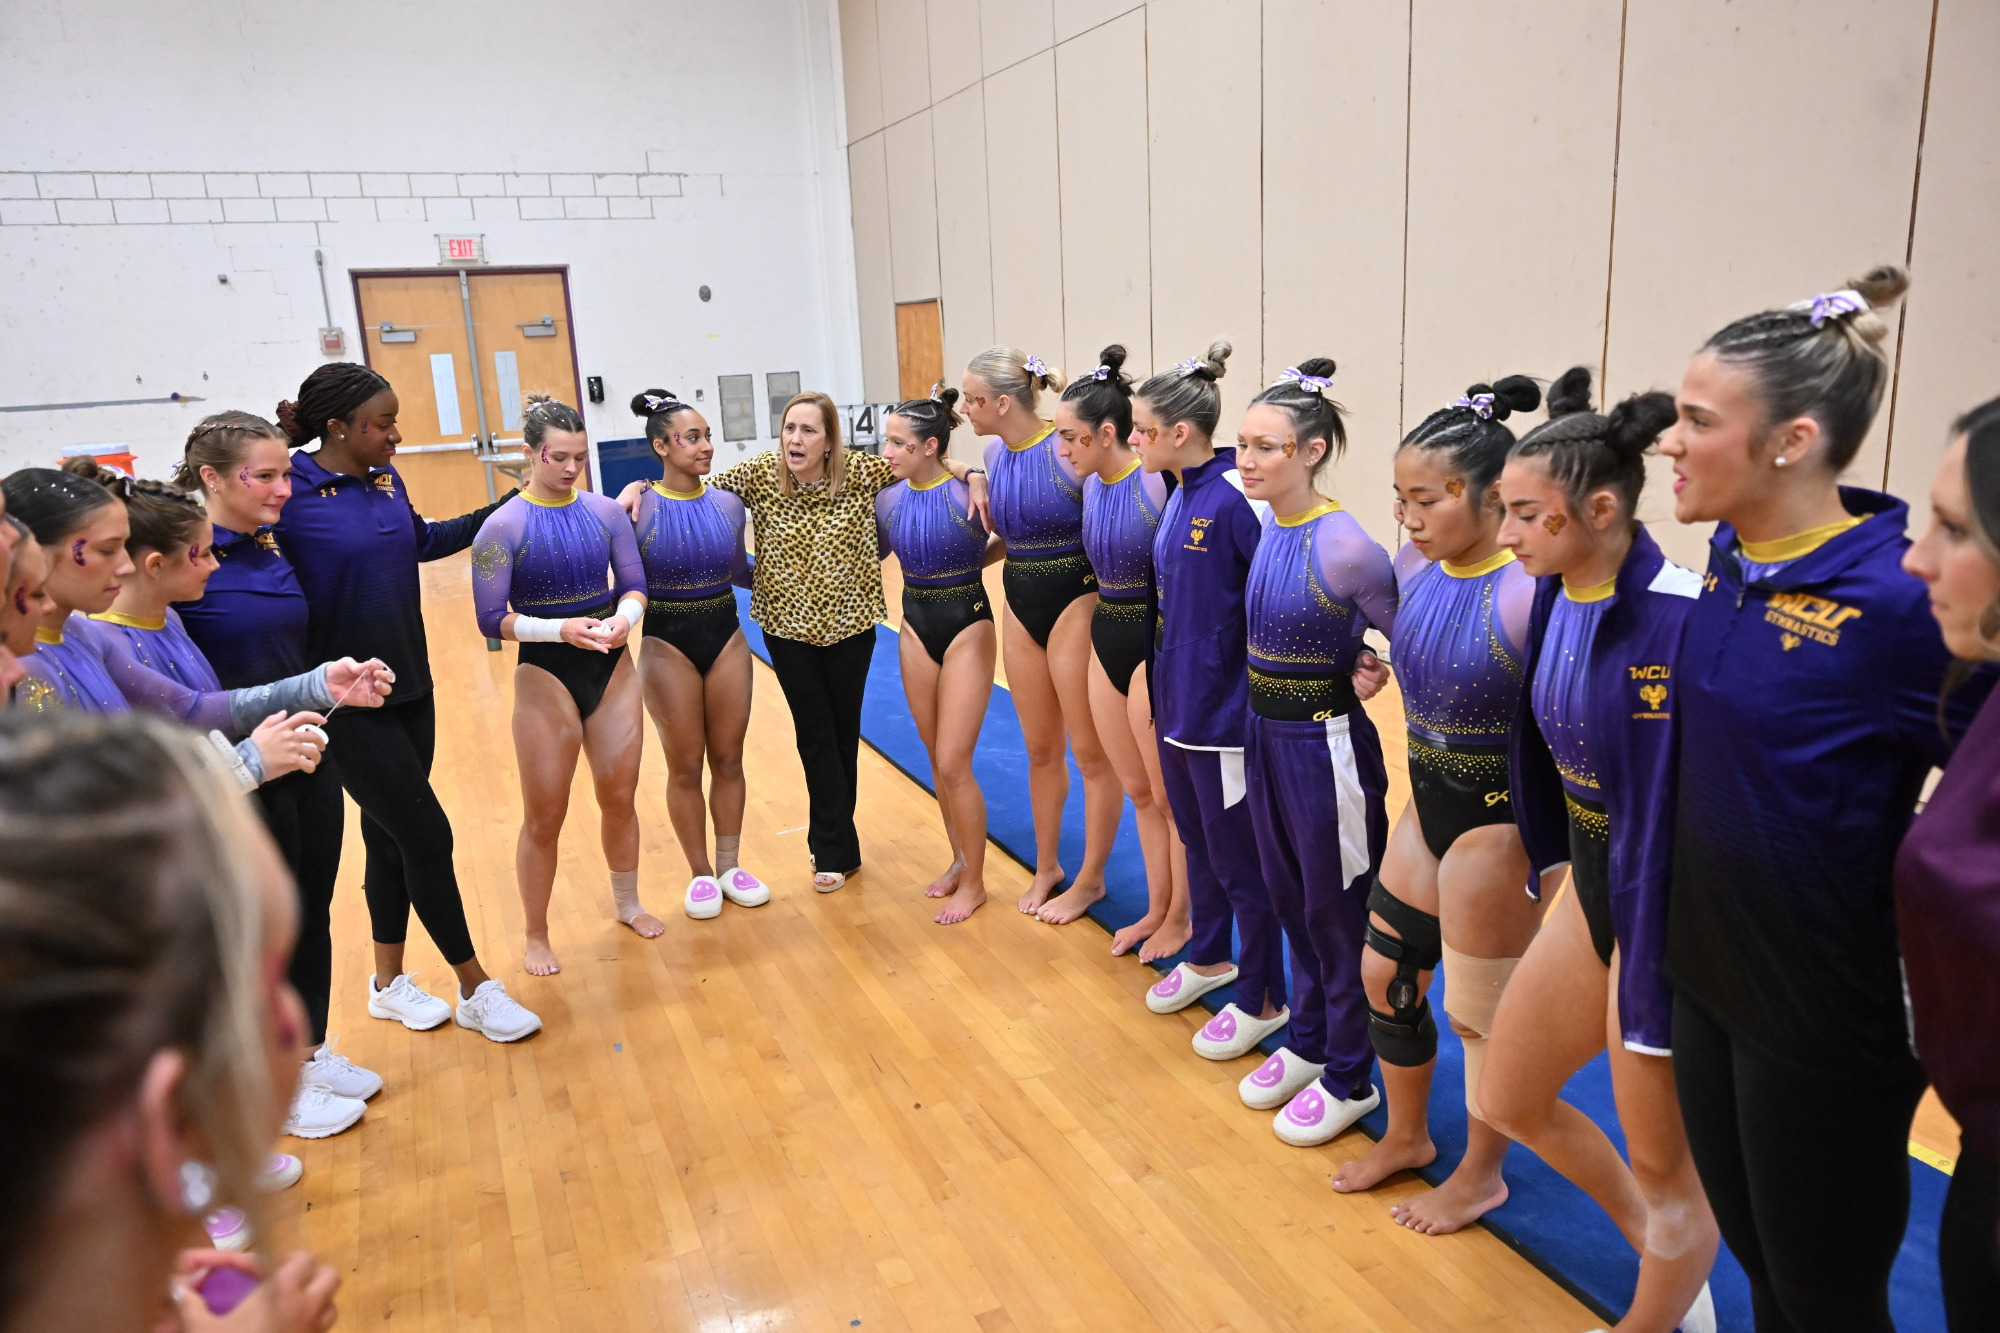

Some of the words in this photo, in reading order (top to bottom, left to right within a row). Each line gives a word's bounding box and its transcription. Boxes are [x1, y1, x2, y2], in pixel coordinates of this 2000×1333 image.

[448, 239, 474, 258] EXIT
[855, 406, 874, 434] 4
[1191, 516, 1214, 528] WCU
[1765, 592, 1863, 630] WCU
[1764, 609, 1840, 647] GYMNASTICS
[1628, 665, 1671, 680] WCU
